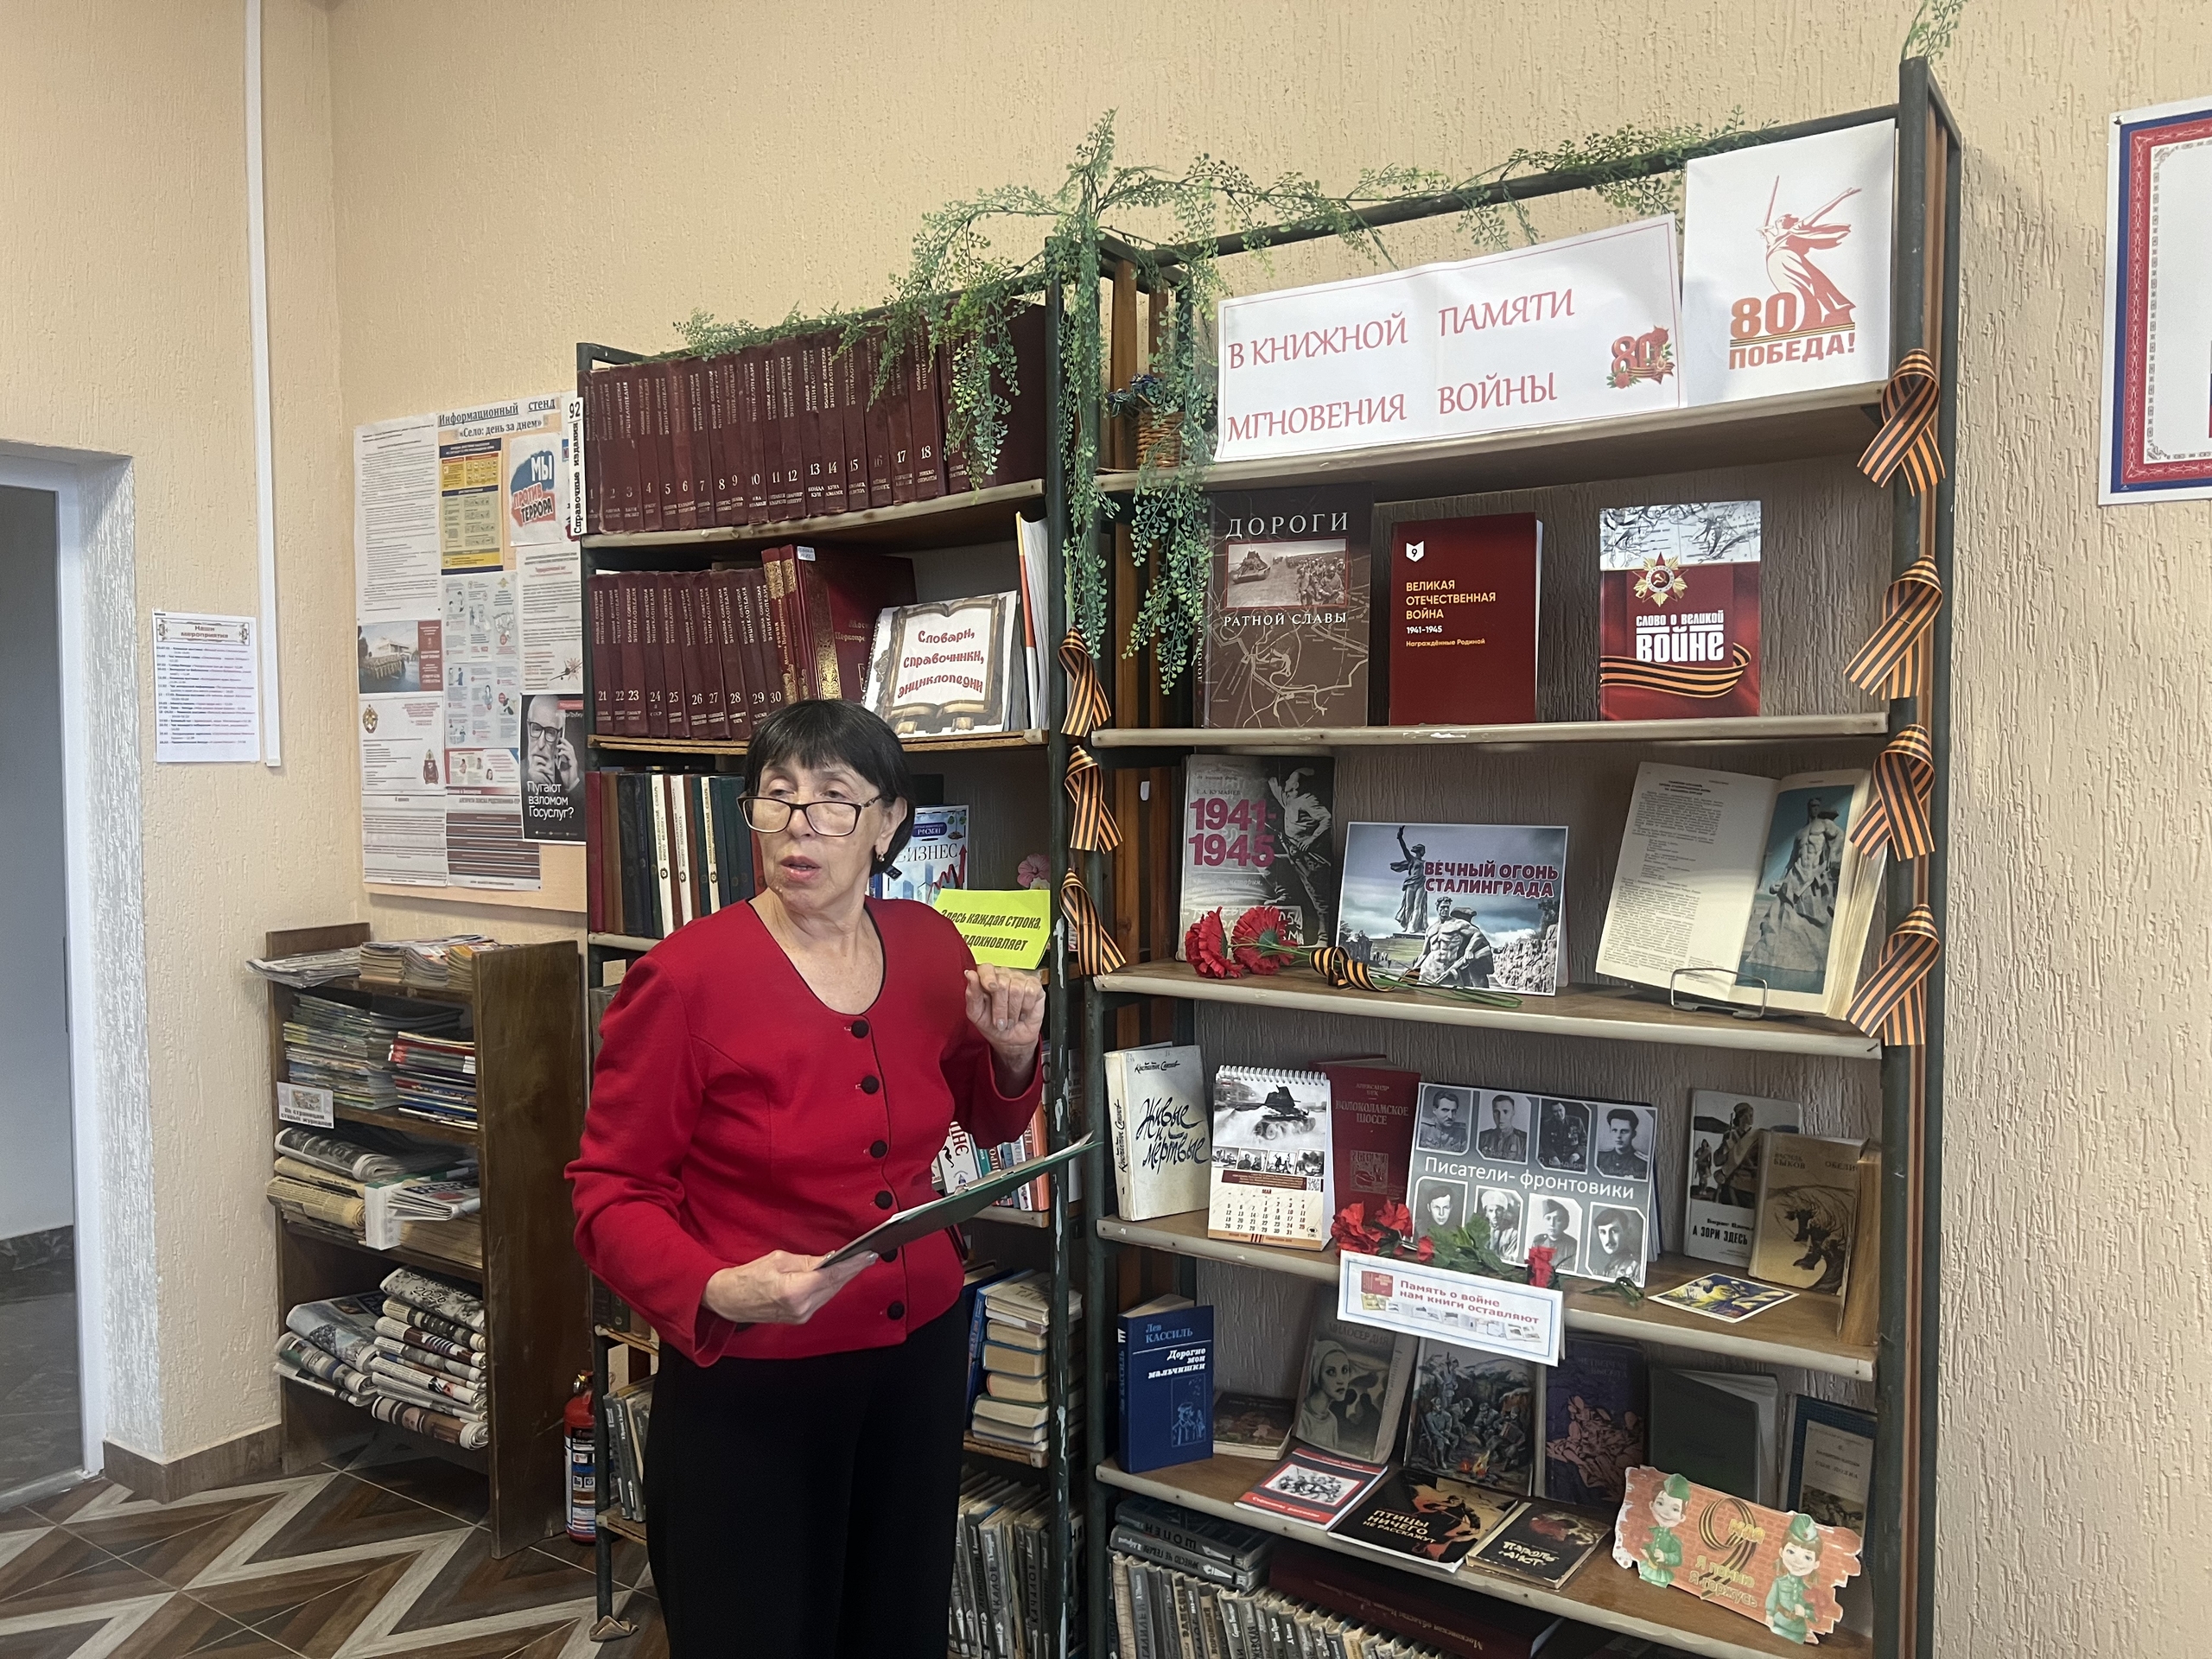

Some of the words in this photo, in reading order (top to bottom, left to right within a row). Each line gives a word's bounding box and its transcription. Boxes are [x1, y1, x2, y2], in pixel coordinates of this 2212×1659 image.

[1731, 291, 1797, 340] 80
[1230, 342, 1244, 369] В
[1253, 310, 1408, 365] КНИЖНОЙ
[1438, 288, 1574, 336] ПАМЯТИ
[1611, 333, 1659, 373] 80
[1729, 333, 1856, 370] ПОБЕДА!
[439, 403, 519, 426] Информационный
[528, 399, 556, 412] стенд
[569, 401, 581, 419] 92
[1227, 392, 1407, 442] МГНОВЕНИЯ
[1438, 372, 1557, 415] ВОЙНЫ
[460, 425, 485, 438] «Село:
[485, 423, 505, 435] день
[505, 423, 515, 432] за
[517, 419, 543, 431] днем»
[897, 450, 906, 462] 17
[921, 446, 931, 459] 18
[531, 454, 554, 481] МЫ
[810, 463, 820, 475] 13
[828, 461, 837, 474] 14
[849, 459, 859, 472] 15
[732, 475, 738, 486] 9
[751, 474, 760, 485] 10
[772, 472, 780, 484] 11
[788, 470, 798, 482] 12
[645, 482, 652, 493] 4
[664, 483, 671, 494] 5
[682, 480, 689, 491] 6
[700, 480, 705, 491] 7
[718, 479, 725, 490] 8
[513, 482, 543, 510] ПРОТИВ
[573, 472, 582, 534] Справочные
[520, 498, 553, 523] ТЕРРОРА
[1225, 512, 1349, 540] ДОРОГИ
[1411, 548, 1418, 557] 9
[1406, 580, 1455, 592] ВЕЛИКАЯ
[1406, 592, 1497, 606] ОТЕЧЕСТВЕННАЯ
[742, 587, 754, 643] ЭНЦИКЛОПЕДИЯ
[764, 584, 772, 641] ЭНЦИКЛОПЕДИЯ
[1224, 612, 1285, 627] РАТНОЙ
[1291, 612, 1348, 626] СЛАВЫ
[1406, 607, 1444, 620] ВОЙНА
[1637, 614, 1666, 626] СЛОВО
[1670, 613, 1676, 626] О
[918, 628, 975, 644] Словари,
[1406, 625, 1443, 634] 1941-1945
[1406, 639, 1456, 648] Награждённые
[1457, 637, 1485, 645] Родиной
[903, 651, 984, 670] справочники,
[898, 673, 983, 699] энциклопедии
[598, 690, 607, 701] 21
[615, 690, 625, 701] 22
[628, 690, 639, 701] 23
[650, 690, 660, 702] 24
[669, 692, 679, 703] 25
[691, 694, 702, 705] 26
[709, 692, 719, 703] 27
[730, 692, 741, 703] 28
[752, 692, 765, 704] 29
[770, 690, 782, 703] 30
[527, 781, 562, 797] Пугают
[528, 794, 569, 806] взломом
[529, 807, 575, 820] Госуслуг?
[1189, 798, 1277, 831] 1941-
[896, 843, 958, 863] БИЗНЕС
[1188, 833, 1274, 868] 1945
[1424, 859, 1496, 879] ВЕЧНЫЙ
[1499, 864, 1559, 880] ОГОНЬ
[1425, 878, 1554, 899] СТАЛИНГРАДА
[969, 913, 1004, 927] каждая
[1005, 916, 1041, 931] строка,
[293, 1108, 325, 1121] страницам
[1335, 1100, 1409, 1116] ВОЛОКОЛАМСКОЕ
[1136, 1096, 1205, 1141] Живые
[1357, 1113, 1388, 1125] ШОССЕ
[1774, 1159, 1806, 1169] БЫКОВ
[1825, 1160, 1857, 1172] ОБЕЛИ
[1425, 1156, 1516, 1183] Писатели-
[1520, 1169, 1634, 1200] фронтовики
[1692, 1225, 1699, 1236] А
[1700, 1226, 1720, 1240] ЗОРИ
[1724, 1230, 1748, 1245] ЗДЕСЬ
[1399, 1280, 1446, 1297] Память
[1462, 1292, 1500, 1307] войне
[1399, 1292, 1424, 1302] нам
[1427, 1295, 1465, 1310] книги
[1468, 1301, 1540, 1325] оставляют
[1146, 1323, 1162, 1334] Лев
[1146, 1328, 1193, 1344] КАССИЛЬ
[1167, 1347, 1206, 1362] Дорогие
[1187, 1355, 1206, 1365] мои
[1147, 1362, 1206, 1379] мальчишки
[1366, 1515, 1429, 1536] НИЧЕГО
[1372, 1509, 1430, 1529] ПТИЦЫ
[1145, 1522, 1197, 1550] ШОПЕН
[1362, 1519, 1378, 1530] НЕ
[1378, 1522, 1437, 1545] РАССКАЖУТ
[1502, 1540, 1560, 1563] ПАРОЛЬ
[1695, 1555, 1707, 1570] Я
[1709, 1561, 1756, 1588] помню
[974, 1557, 986, 1610] ЛЕРМОНТОВ
[989, 1567, 1002, 1615] ЧКАЛОВ
[1689, 1571, 1701, 1584] Я
[1702, 1574, 1758, 1608] горжусь
[1029, 1565, 1039, 1624] КАЧАЛОВ
[1137, 1603, 1150, 1658] ГАЛИЛЕЙ
